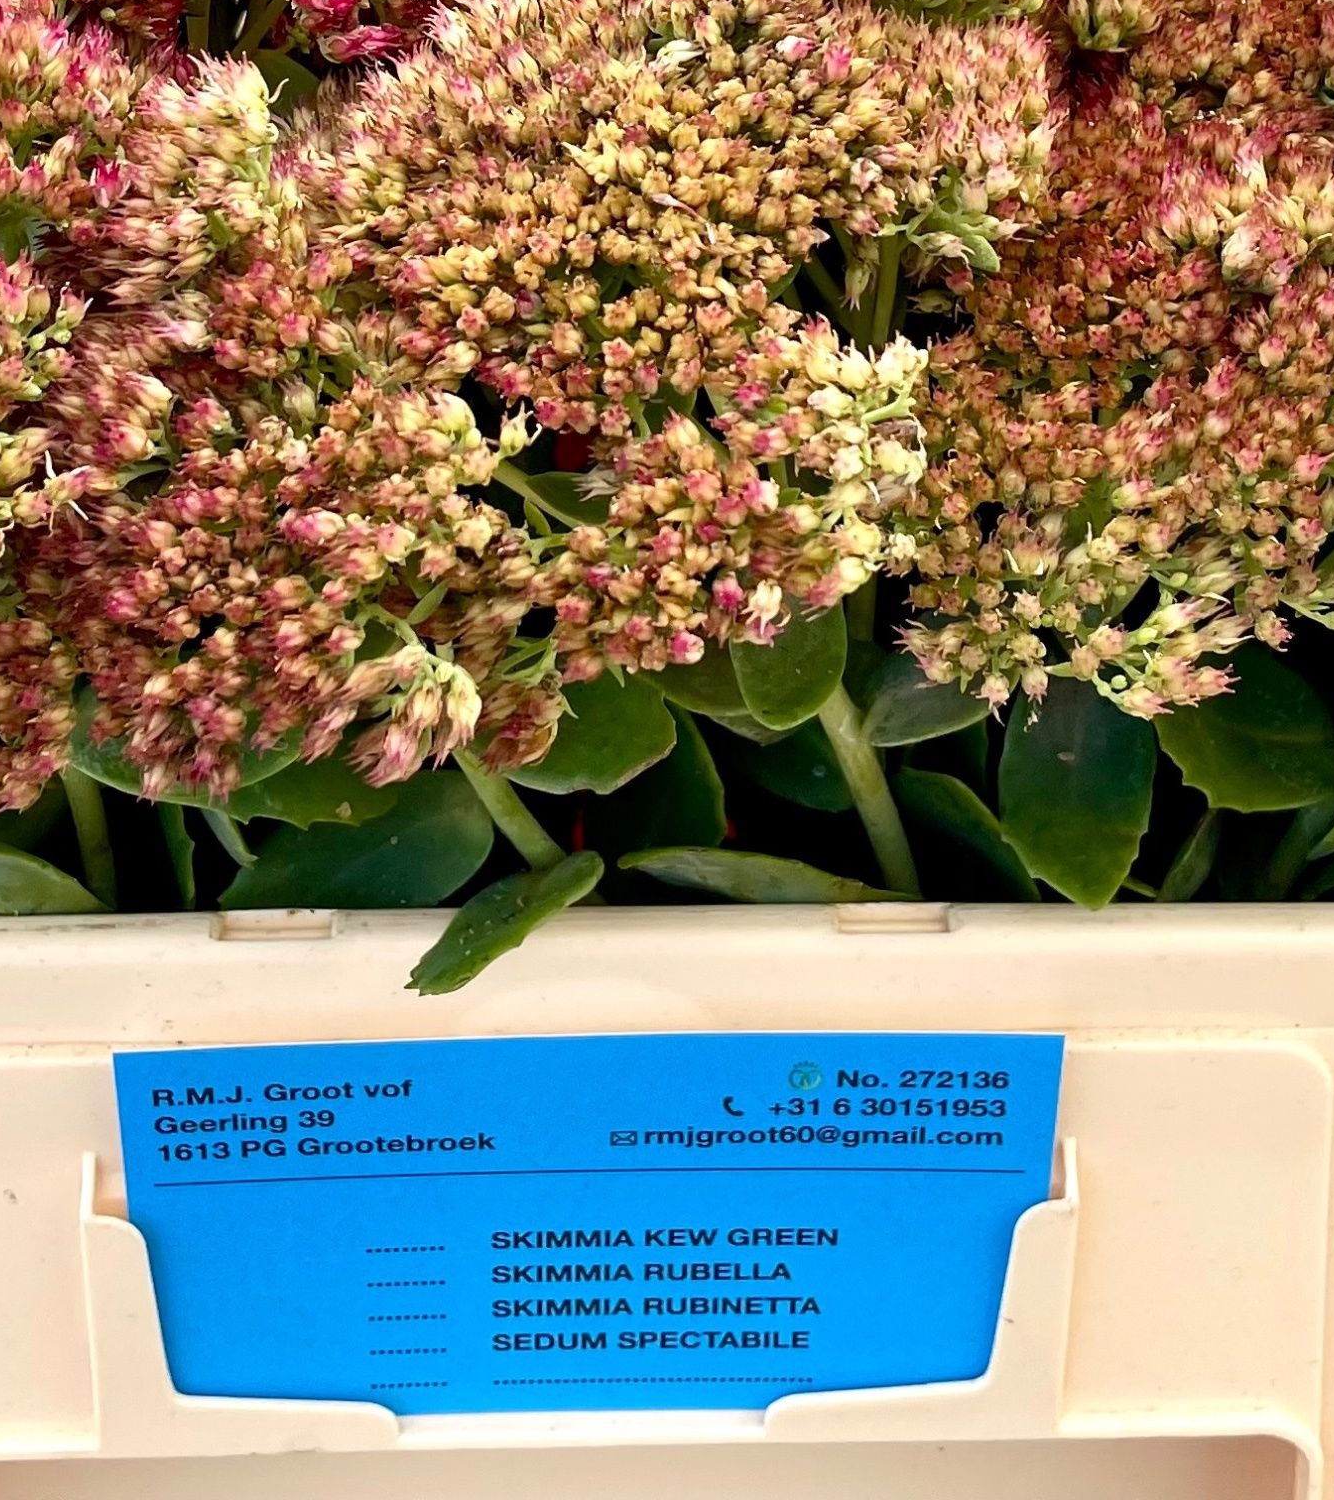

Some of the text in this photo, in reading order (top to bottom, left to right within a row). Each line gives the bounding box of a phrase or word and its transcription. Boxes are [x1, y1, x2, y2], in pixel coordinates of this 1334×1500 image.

[837, 1069, 1010, 1089] No. 272136
[151, 1079, 413, 1107] R.M.J. Groot vof
[768, 1098, 1007, 1117] +31 6 30151953
[154, 1110, 335, 1135] Geerling 39
[644, 1125, 1003, 1148] rmjgroot60@gmail.com
[158, 1133, 496, 1162] 1613 PG Grootebroek
[491, 1228, 839, 1249] SKIMMIA KEW GREEN
[491, 1262, 792, 1284] SKIMMIA RUBELLA
[491, 1297, 821, 1318] SKIMMIA RUBINETTA
[492, 1331, 811, 1352] SEDUM SPECTABILE
